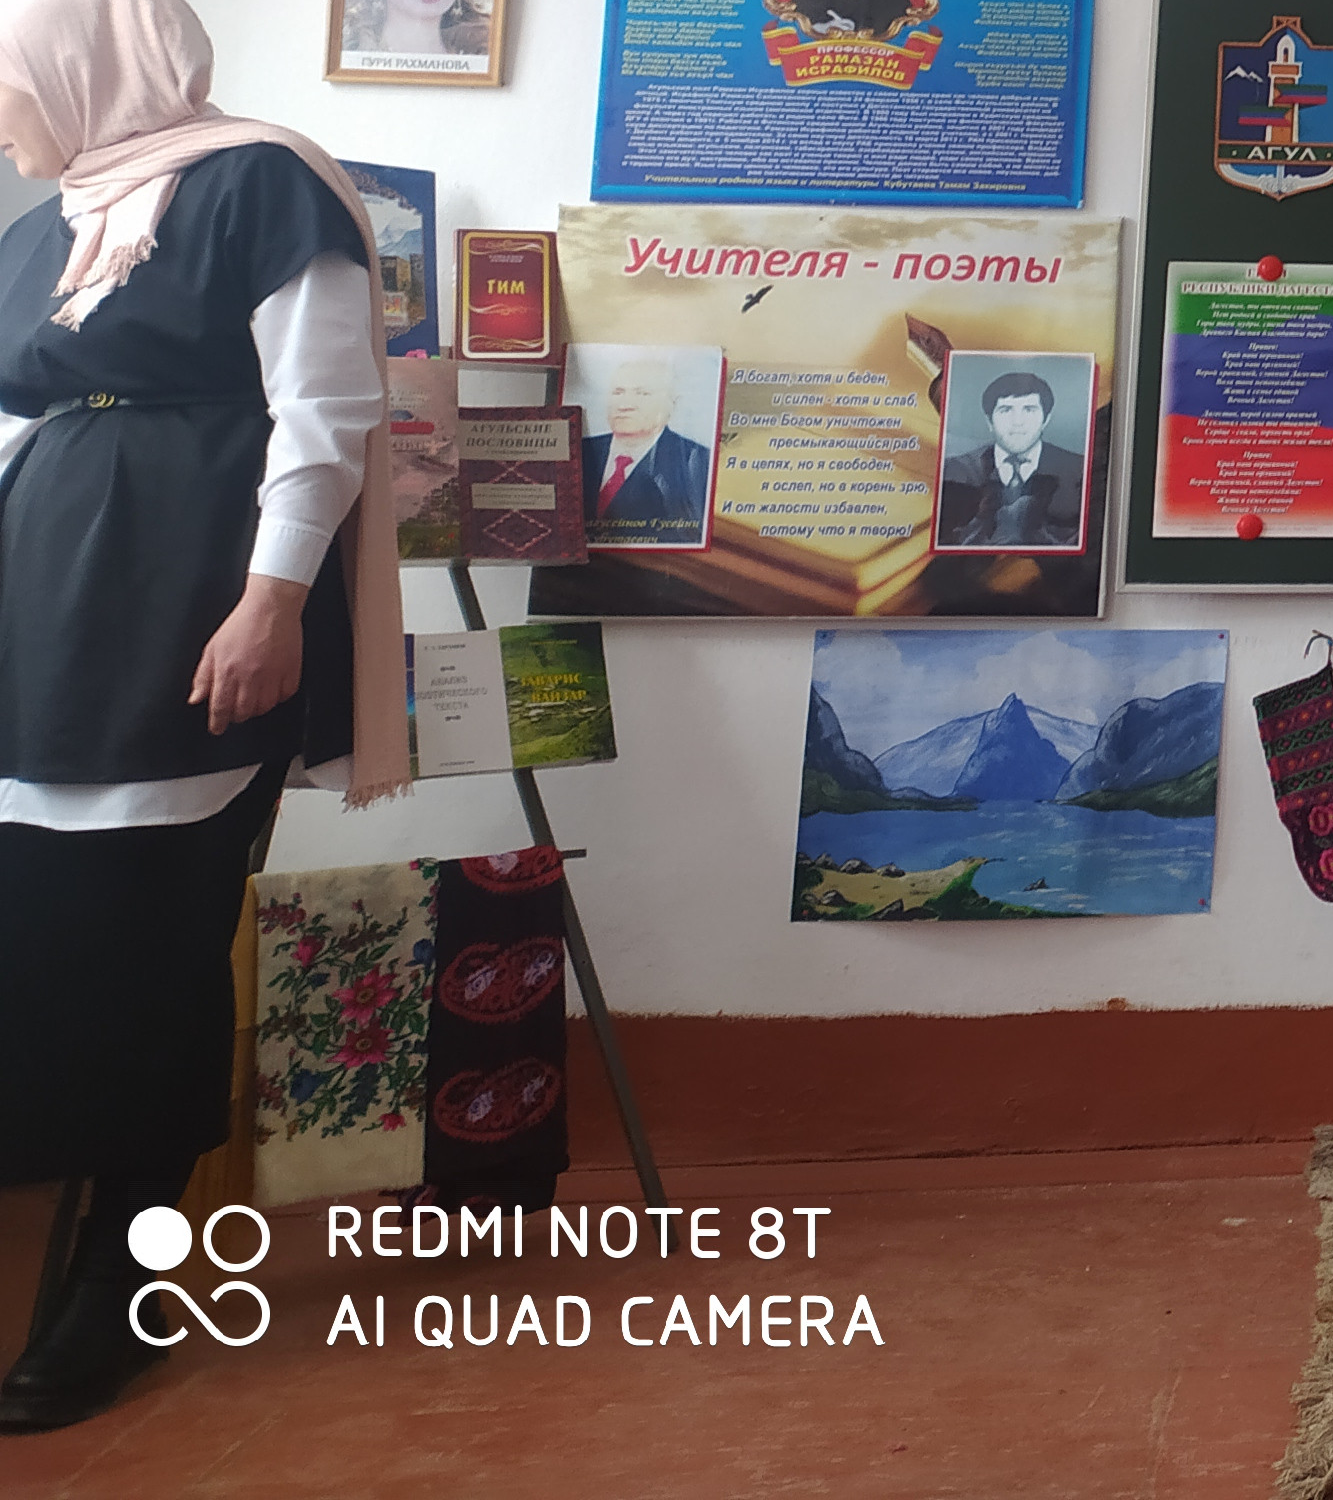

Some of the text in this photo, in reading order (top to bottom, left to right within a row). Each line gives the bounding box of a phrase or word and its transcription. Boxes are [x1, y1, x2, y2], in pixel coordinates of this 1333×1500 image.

[817, 46, 894, 58] ПРОФЕССОР
[361, 57, 470, 71] ГУРИ РАХМАНОВА
[809, 54, 900, 71] РАМАЗАН
[796, 65, 906, 83] ИСРАФИЛОВ
[1247, 145, 1318, 161] АГУЛ
[624, 236, 850, 279] Учителя
[892, 253, 1064, 284] поэты
[487, 279, 525, 295] ТИМ
[732, 370, 889, 386] Я богат, хотя и беден,
[773, 395, 781, 404] и
[784, 395, 823, 404] силен
[835, 395, 869, 405] хотя
[873, 395, 881, 404] и
[884, 392, 918, 407] слаб,
[730, 413, 902, 429] Во мне Богом уничтожен
[768, 436, 890, 450] пресмыкающийся
[726, 457, 737, 469] Я
[751, 460, 793, 471] цепях,
[797, 460, 813, 470] но
[816, 460, 825, 470] я
[828, 457, 894, 471] свободен,
[761, 481, 769, 491] я
[772, 482, 815, 493] ослеп,
[819, 482, 835, 491] но
[850, 482, 896, 493] корень
[721, 501, 888, 515] И от жалости избавлен,
[760, 524, 912, 538] потому что я творю!
